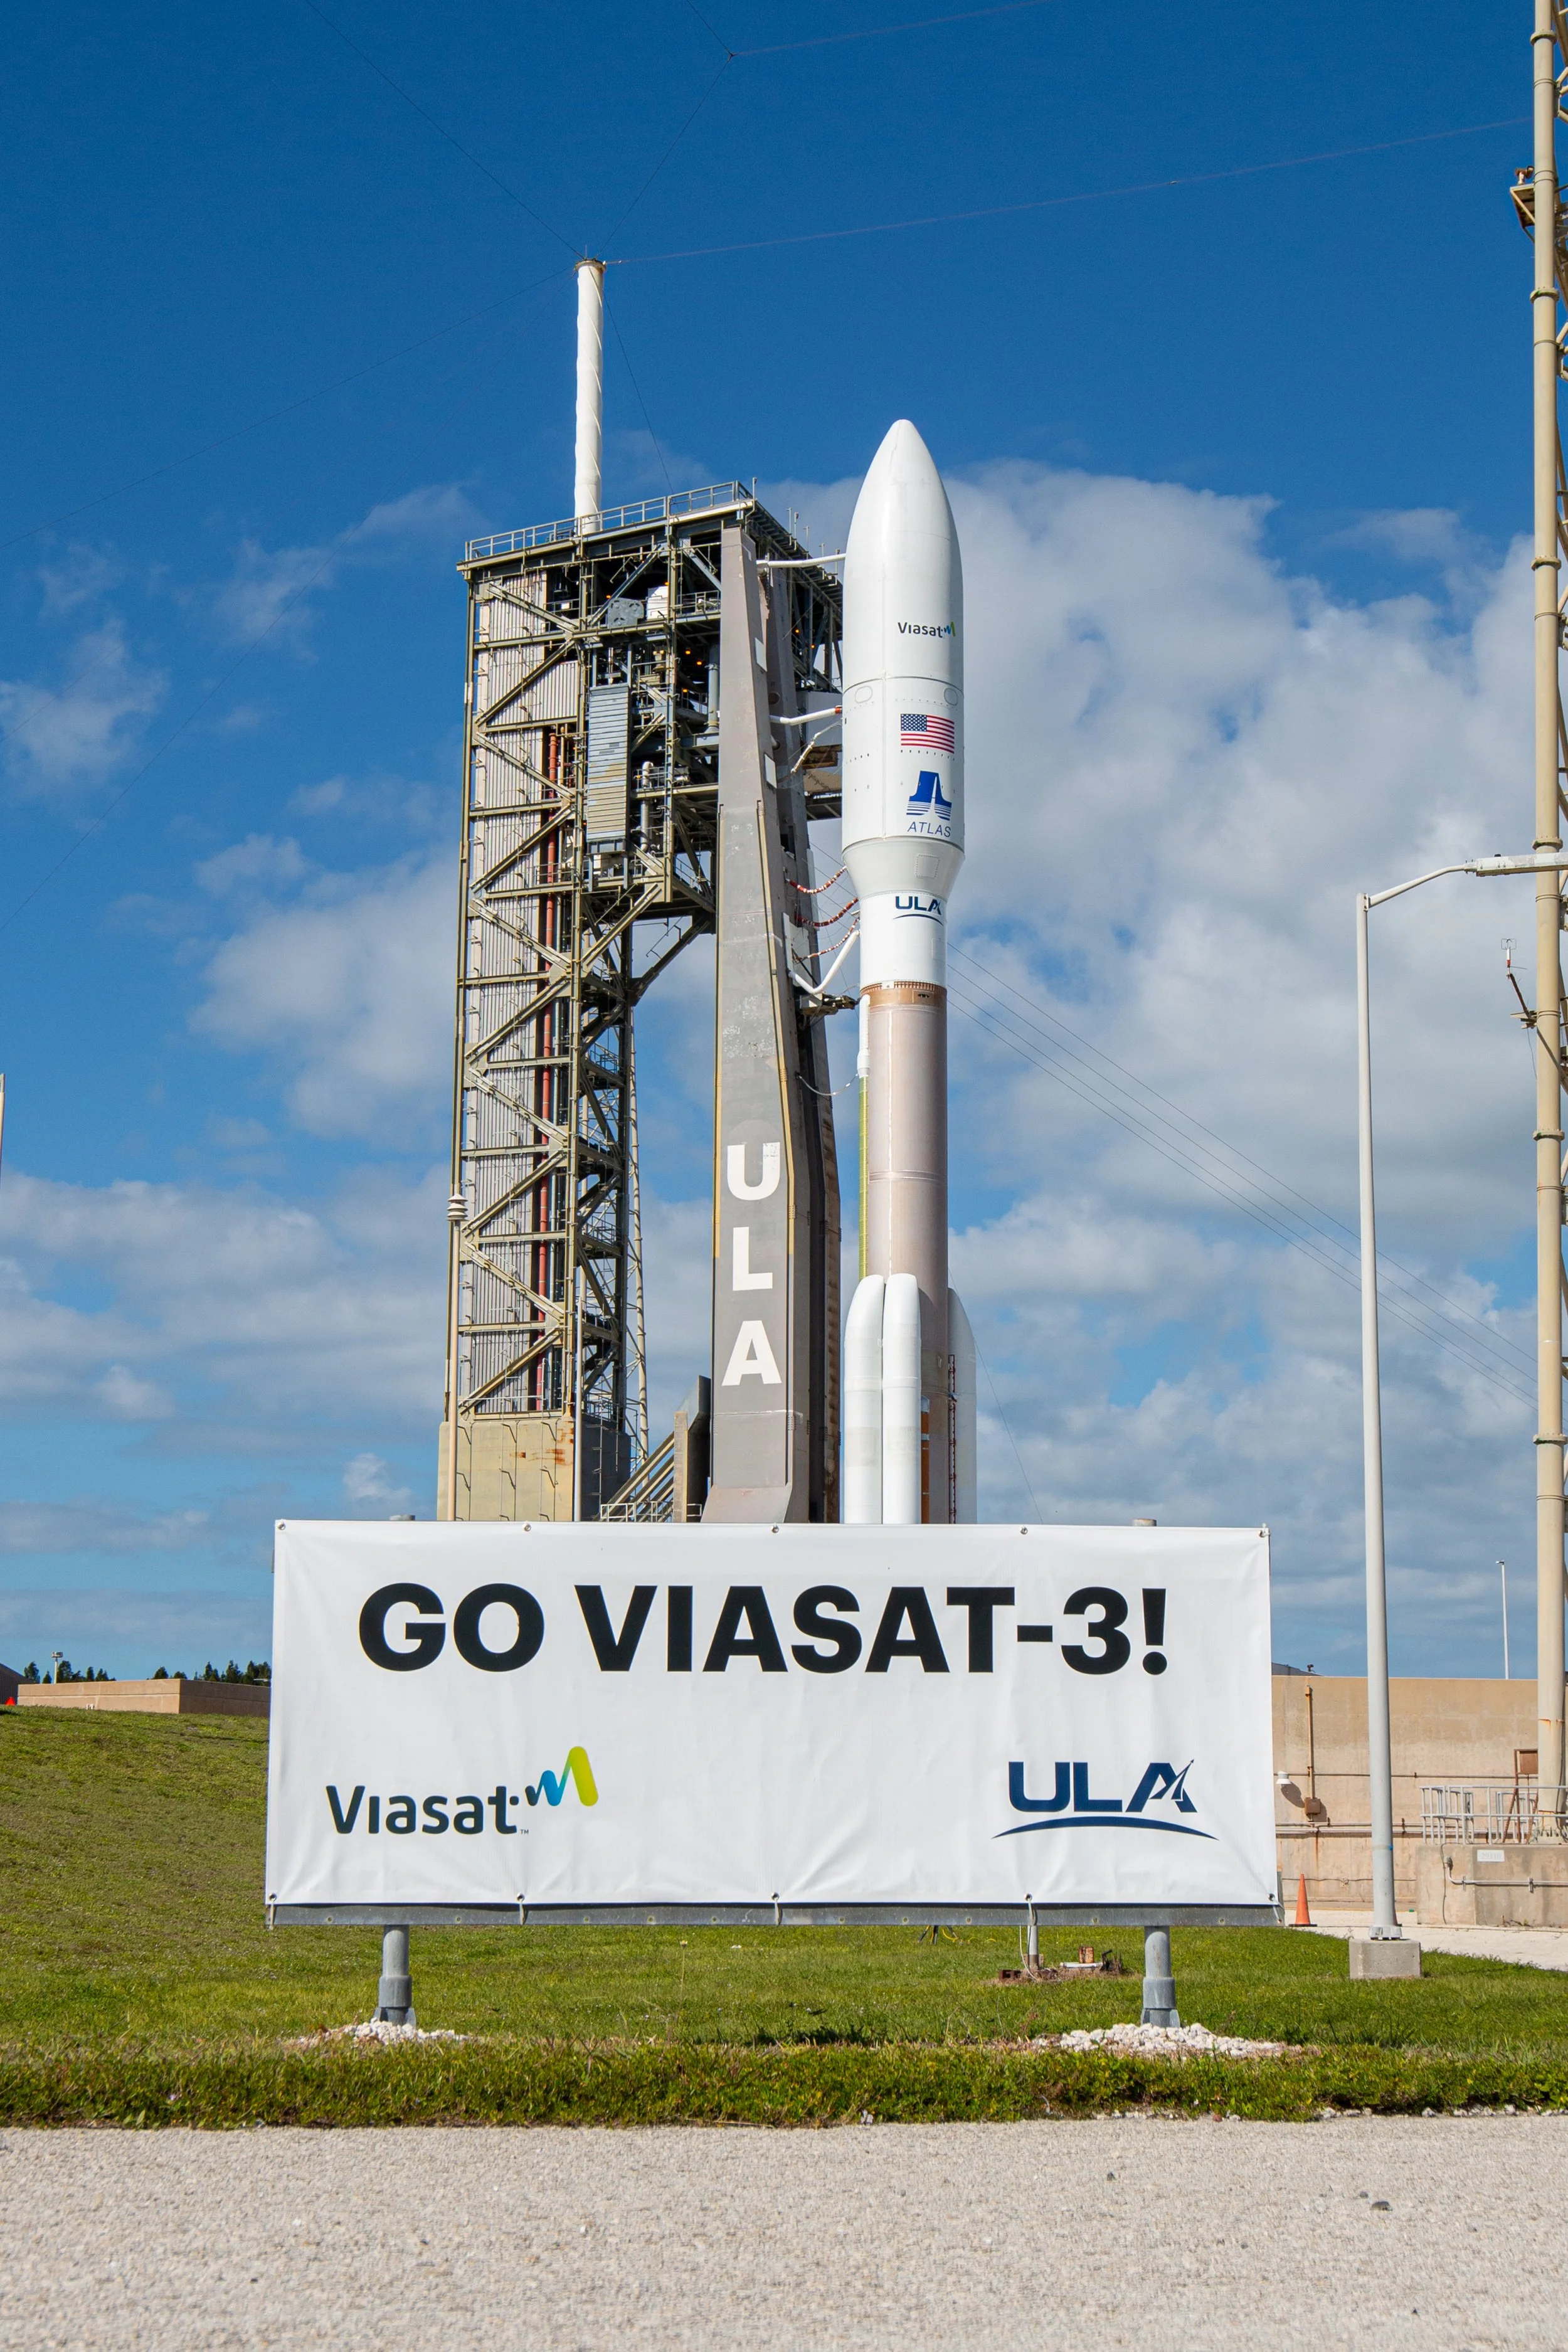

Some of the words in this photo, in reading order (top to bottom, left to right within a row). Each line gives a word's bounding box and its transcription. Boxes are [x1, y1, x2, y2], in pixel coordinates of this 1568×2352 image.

[898, 622, 943, 638] Viasat
[907, 821, 951, 837] ATLAS
[895, 896, 941, 915] ULA
[722, 1142, 781, 1386] ULA
[359, 1582, 544, 1672] GO
[574, 1584, 1168, 1675] VIASAT-3!
[326, 1785, 519, 1835] Viasat
[1008, 1759, 1198, 1813] ULA
